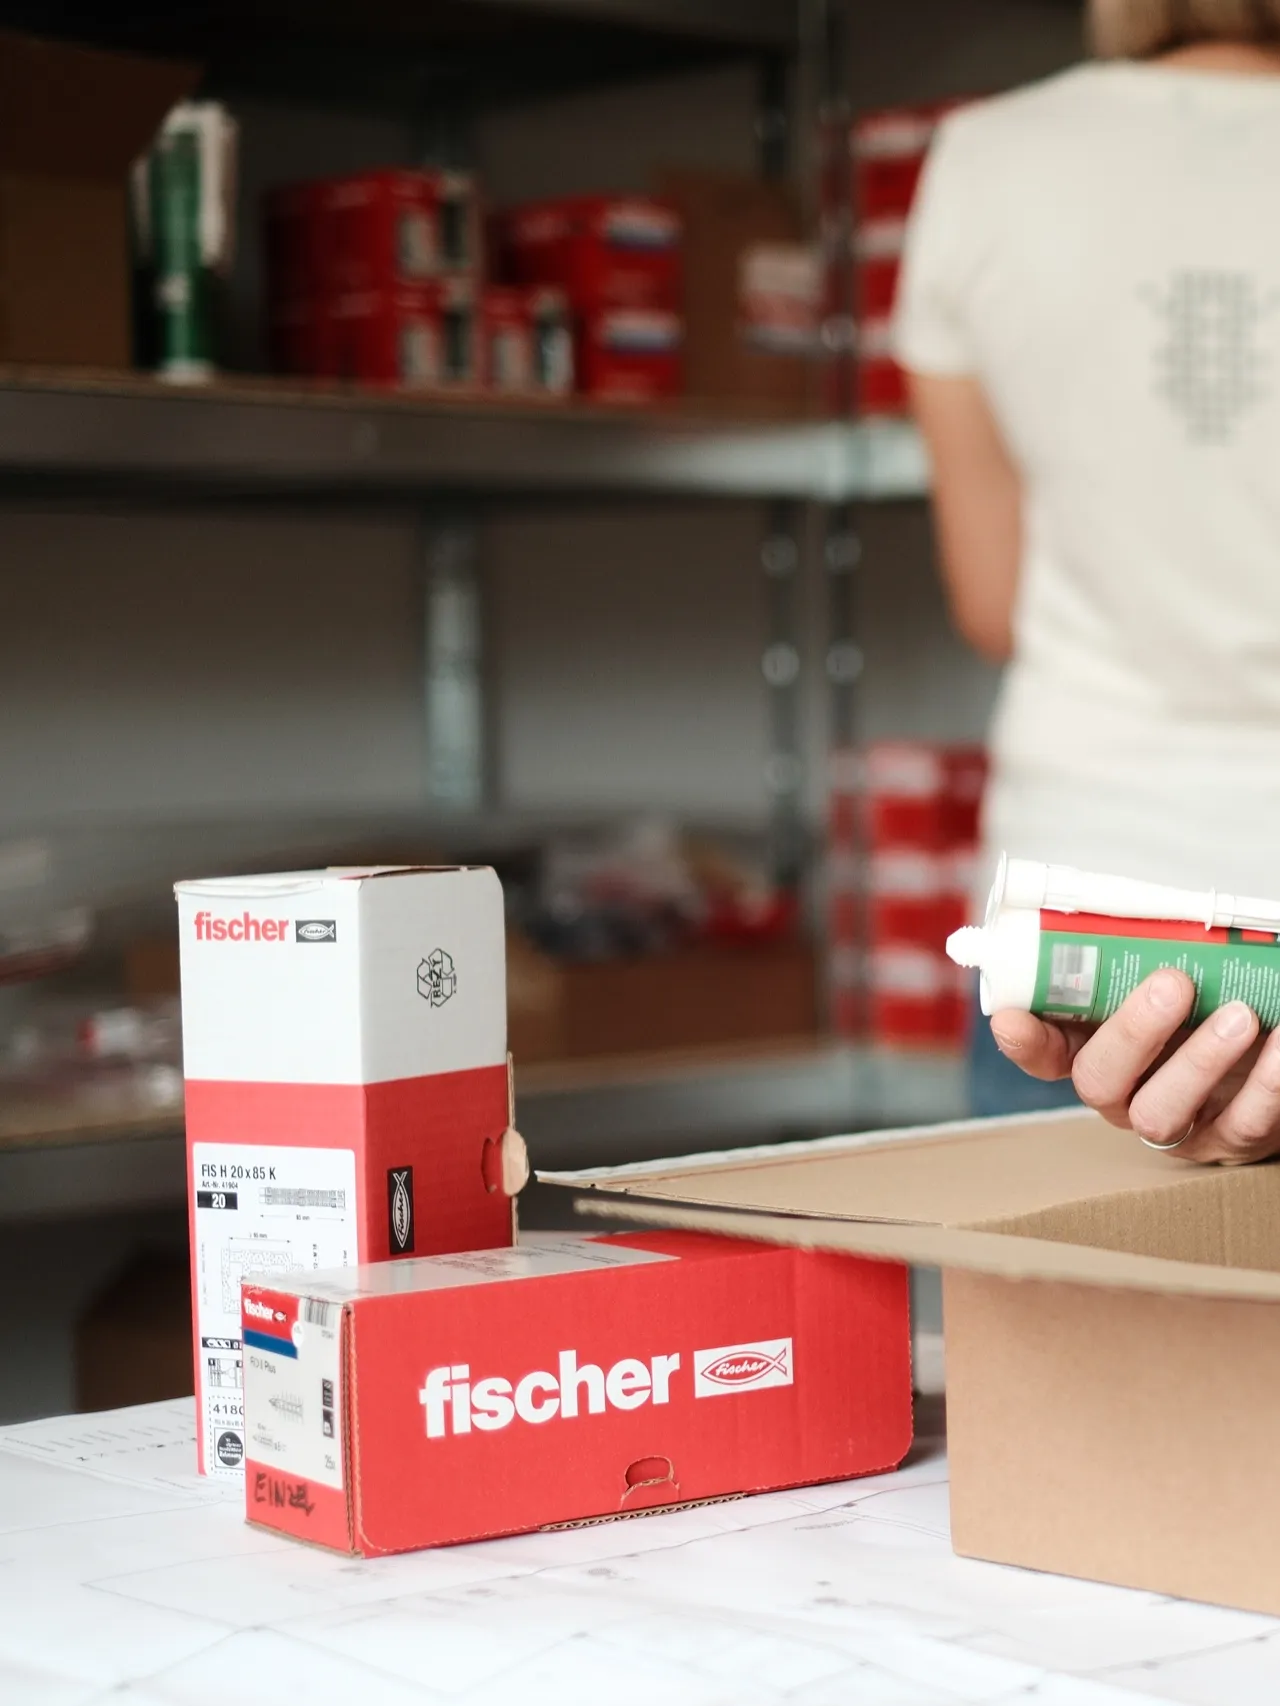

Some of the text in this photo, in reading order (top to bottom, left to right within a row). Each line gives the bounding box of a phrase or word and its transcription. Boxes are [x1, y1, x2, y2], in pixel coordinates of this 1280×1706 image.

[194, 911, 290, 941] fischer
[430, 958, 442, 998] REZY
[201, 1163, 217, 1177] FIS
[220, 1164, 227, 1178] H
[269, 1166, 277, 1180] K
[211, 1192, 226, 1209] 20
[396, 1192, 406, 1237] fischer
[243, 1298, 274, 1321] fischer
[715, 1359, 767, 1377] fischer
[419, 1350, 680, 1438] fischer
